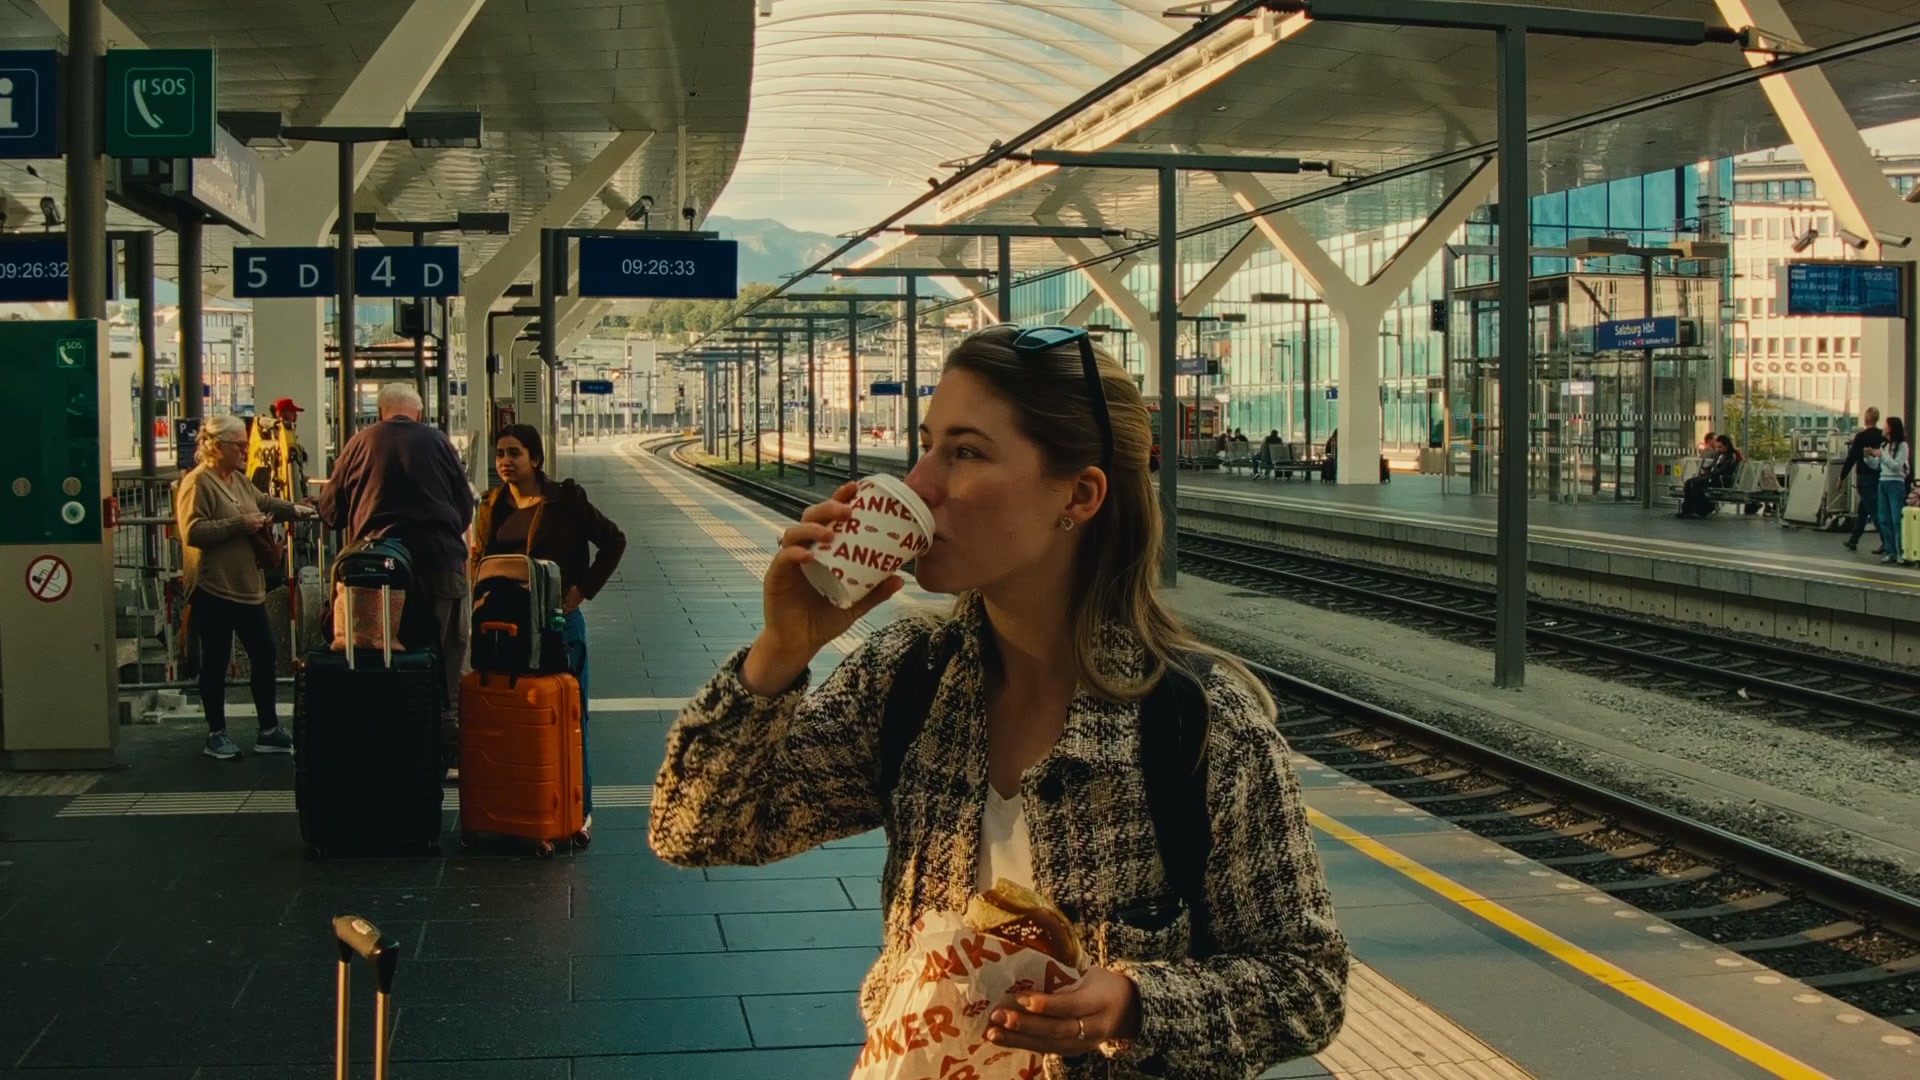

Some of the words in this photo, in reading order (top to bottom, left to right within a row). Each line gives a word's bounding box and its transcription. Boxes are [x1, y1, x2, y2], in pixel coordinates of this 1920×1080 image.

[151, 78, 186, 95] SOS
[247, 256, 268, 288] 5
[299, 264, 320, 288] D
[371, 255, 396, 287] 4
[423, 263, 444, 287] D
[622, 258, 695, 276] 09:26:33
[1614, 323, 1641, 337] Salzburg
[66, 341, 82, 350] SOS
[1752, 361, 1847, 373] cocoon
[180, 422, 187, 434] P
[852, 496, 918, 523] ANKE
[833, 542, 903, 572] ANKER
[857, 1005, 960, 1070] NKER
